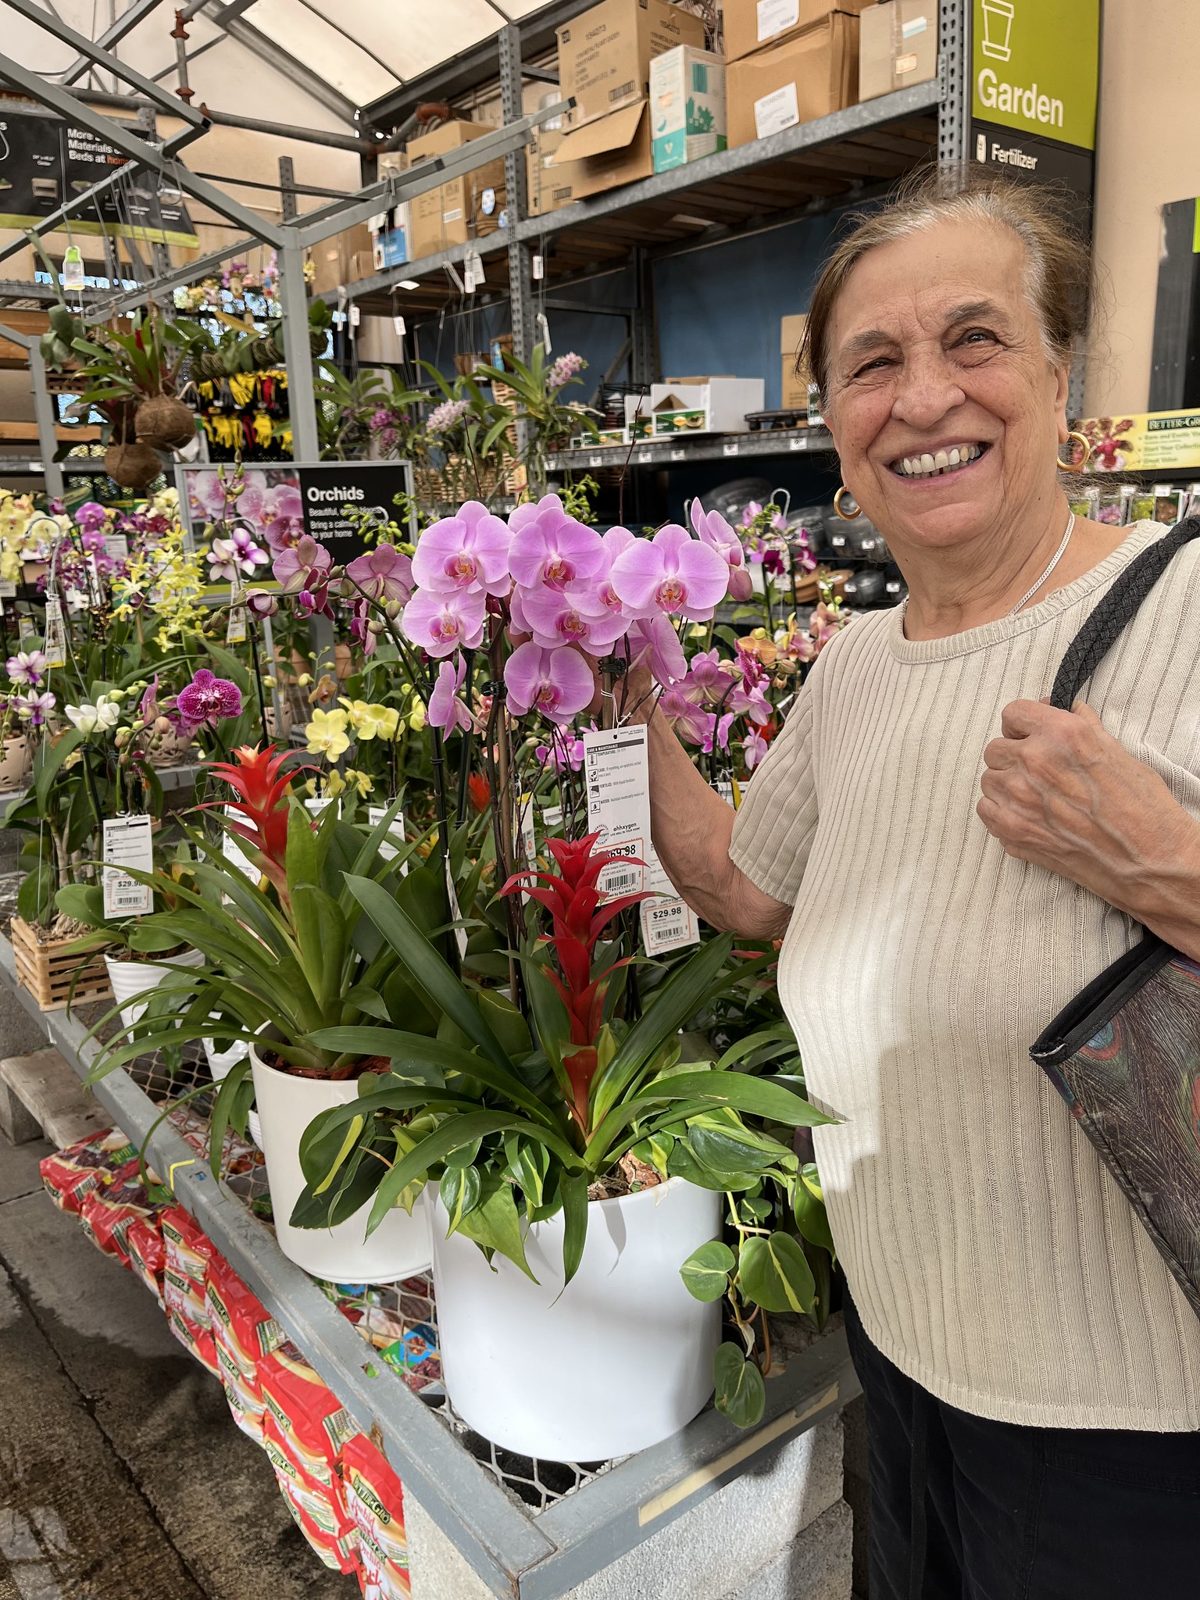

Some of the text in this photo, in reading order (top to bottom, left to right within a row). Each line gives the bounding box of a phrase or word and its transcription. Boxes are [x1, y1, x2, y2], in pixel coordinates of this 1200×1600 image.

[978, 68, 1063, 127] Garden
[67, 128, 93, 141] More
[68, 139, 113, 154] Materials
[69, 150, 93, 164] Beds
[95, 154, 106, 164] at
[992, 143, 1038, 170] Fertilizer
[1149, 416, 1200, 431] BETTER-GR
[307, 486, 365, 502] Orchids
[308, 507, 340, 517] Beautiful,
[310, 521, 328, 530] Bring
[319, 532, 333, 540] your
[334, 530, 353, 538] home
[608, 844, 636, 858] 69.98
[652, 906, 682, 919] $29.98
